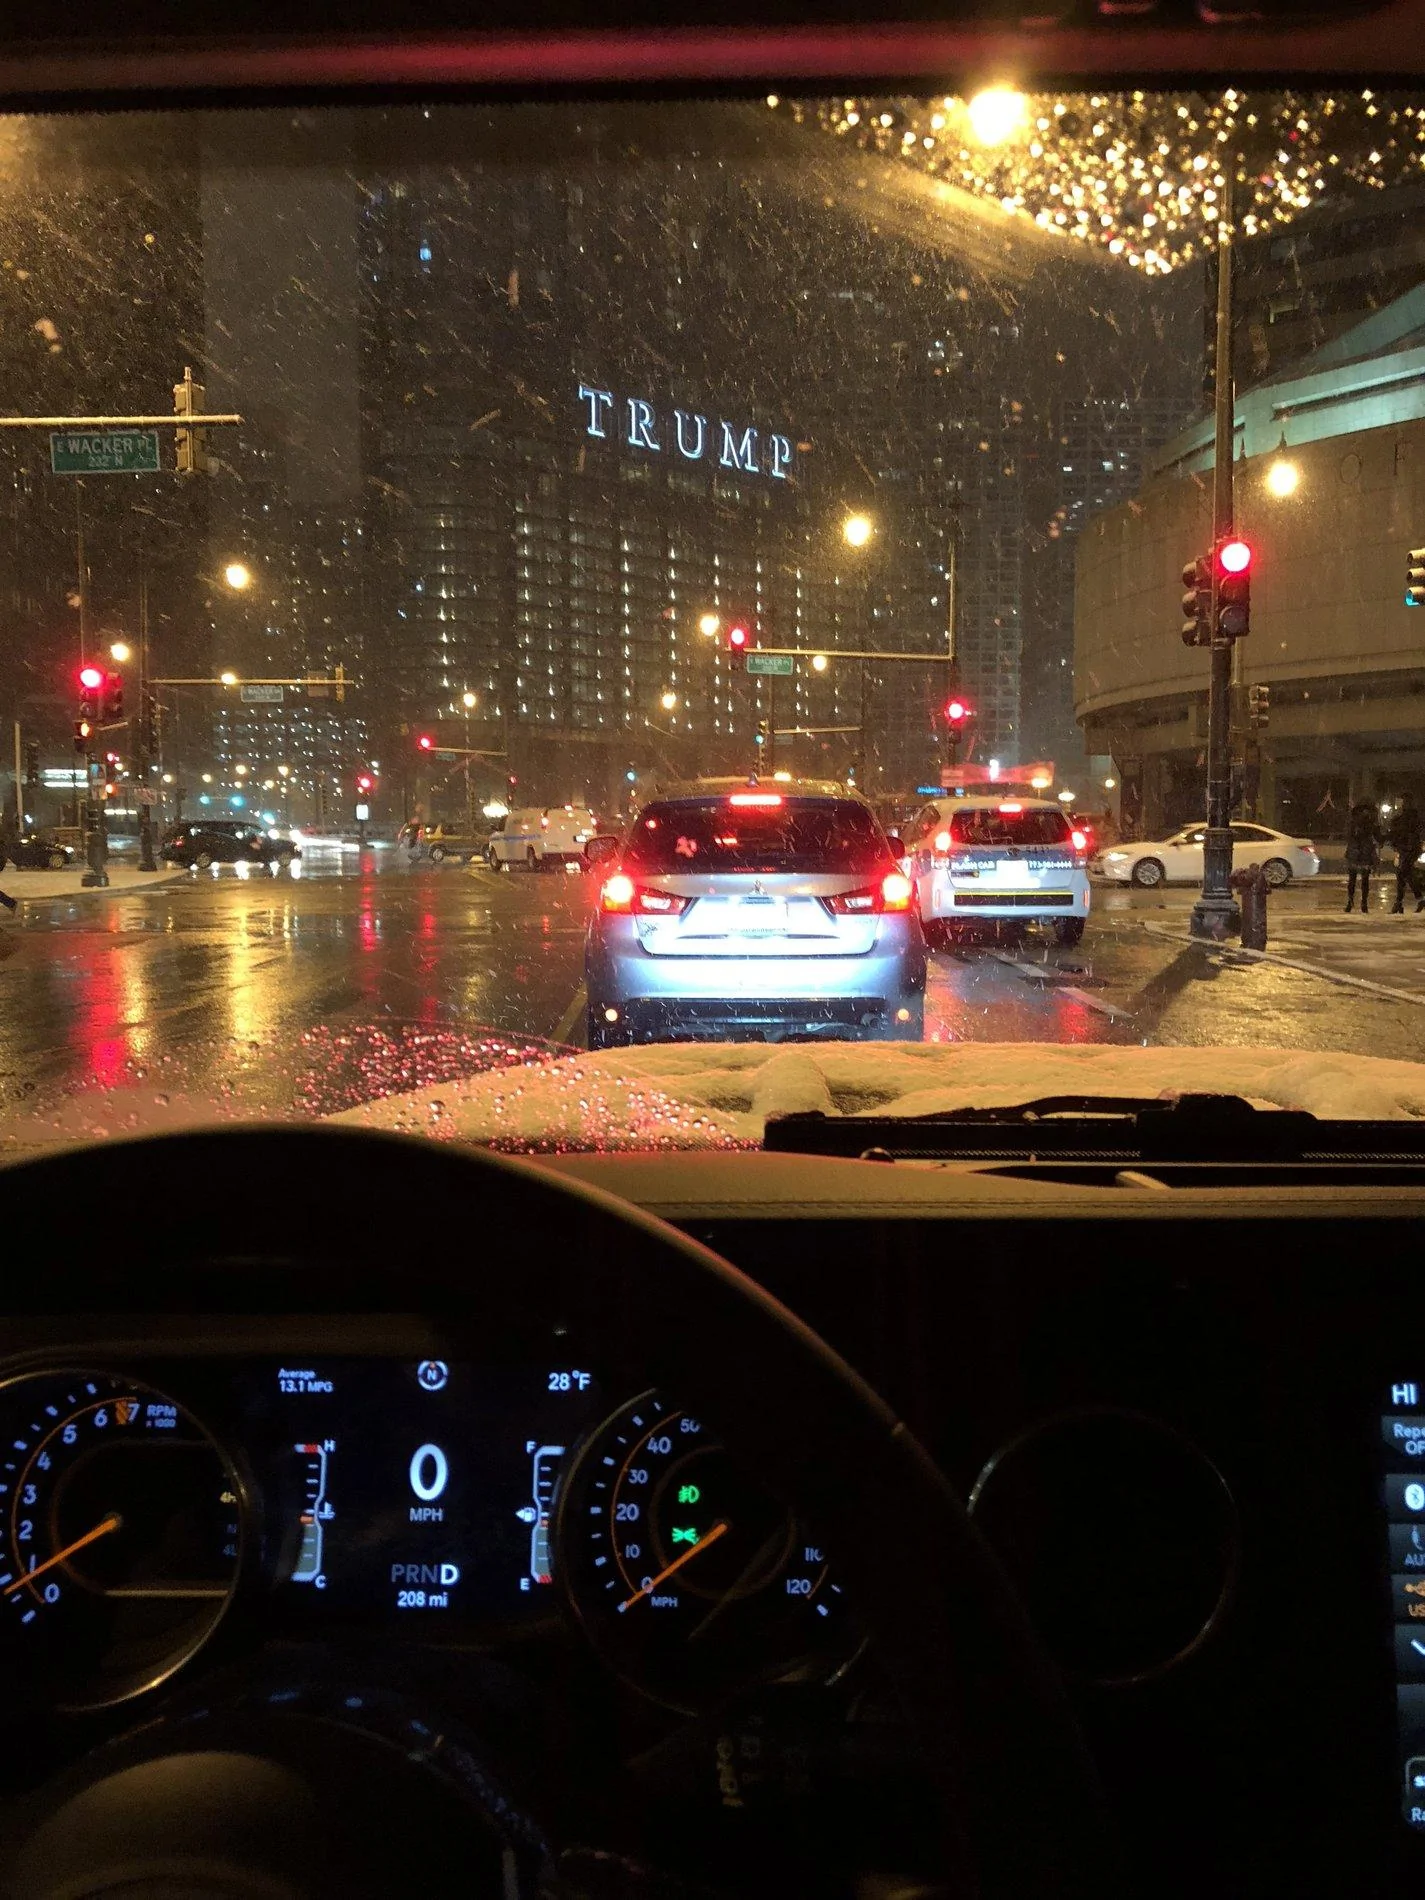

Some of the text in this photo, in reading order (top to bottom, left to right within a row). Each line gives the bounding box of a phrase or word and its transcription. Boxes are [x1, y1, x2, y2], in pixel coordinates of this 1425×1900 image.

[578, 384, 793, 479] TRUMP
[56, 440, 65, 453] E
[68, 438, 133, 454] WACKER
[278, 1367, 317, 1380] Average
[427, 1369, 437, 1381] N
[279, 1380, 333, 1393] 13.1 MPG
[1391, 1382, 1418, 1405] HI
[94, 1408, 108, 1428] 6
[127, 1402, 140, 1423] 7
[146, 1404, 177, 1417] RPM
[62, 1424, 77, 1444] 5
[324, 1440, 335, 1452] H
[526, 1441, 535, 1453] F
[646, 1437, 672, 1454] 40
[37, 1451, 51, 1471] 4
[409, 1443, 449, 1501] 0
[628, 1469, 649, 1485] 30
[22, 1484, 37, 1505] 3
[409, 1507, 444, 1522] MPH
[615, 1504, 640, 1521] 20
[19, 1519, 34, 1540] 2
[625, 1544, 641, 1559] 10
[315, 1576, 327, 1589] C
[519, 1578, 530, 1591] E
[786, 1578, 812, 1595] 120
[44, 1583, 60, 1603] 0
[397, 1591, 449, 1608] 208 mi
[650, 1596, 679, 1608] MPH
